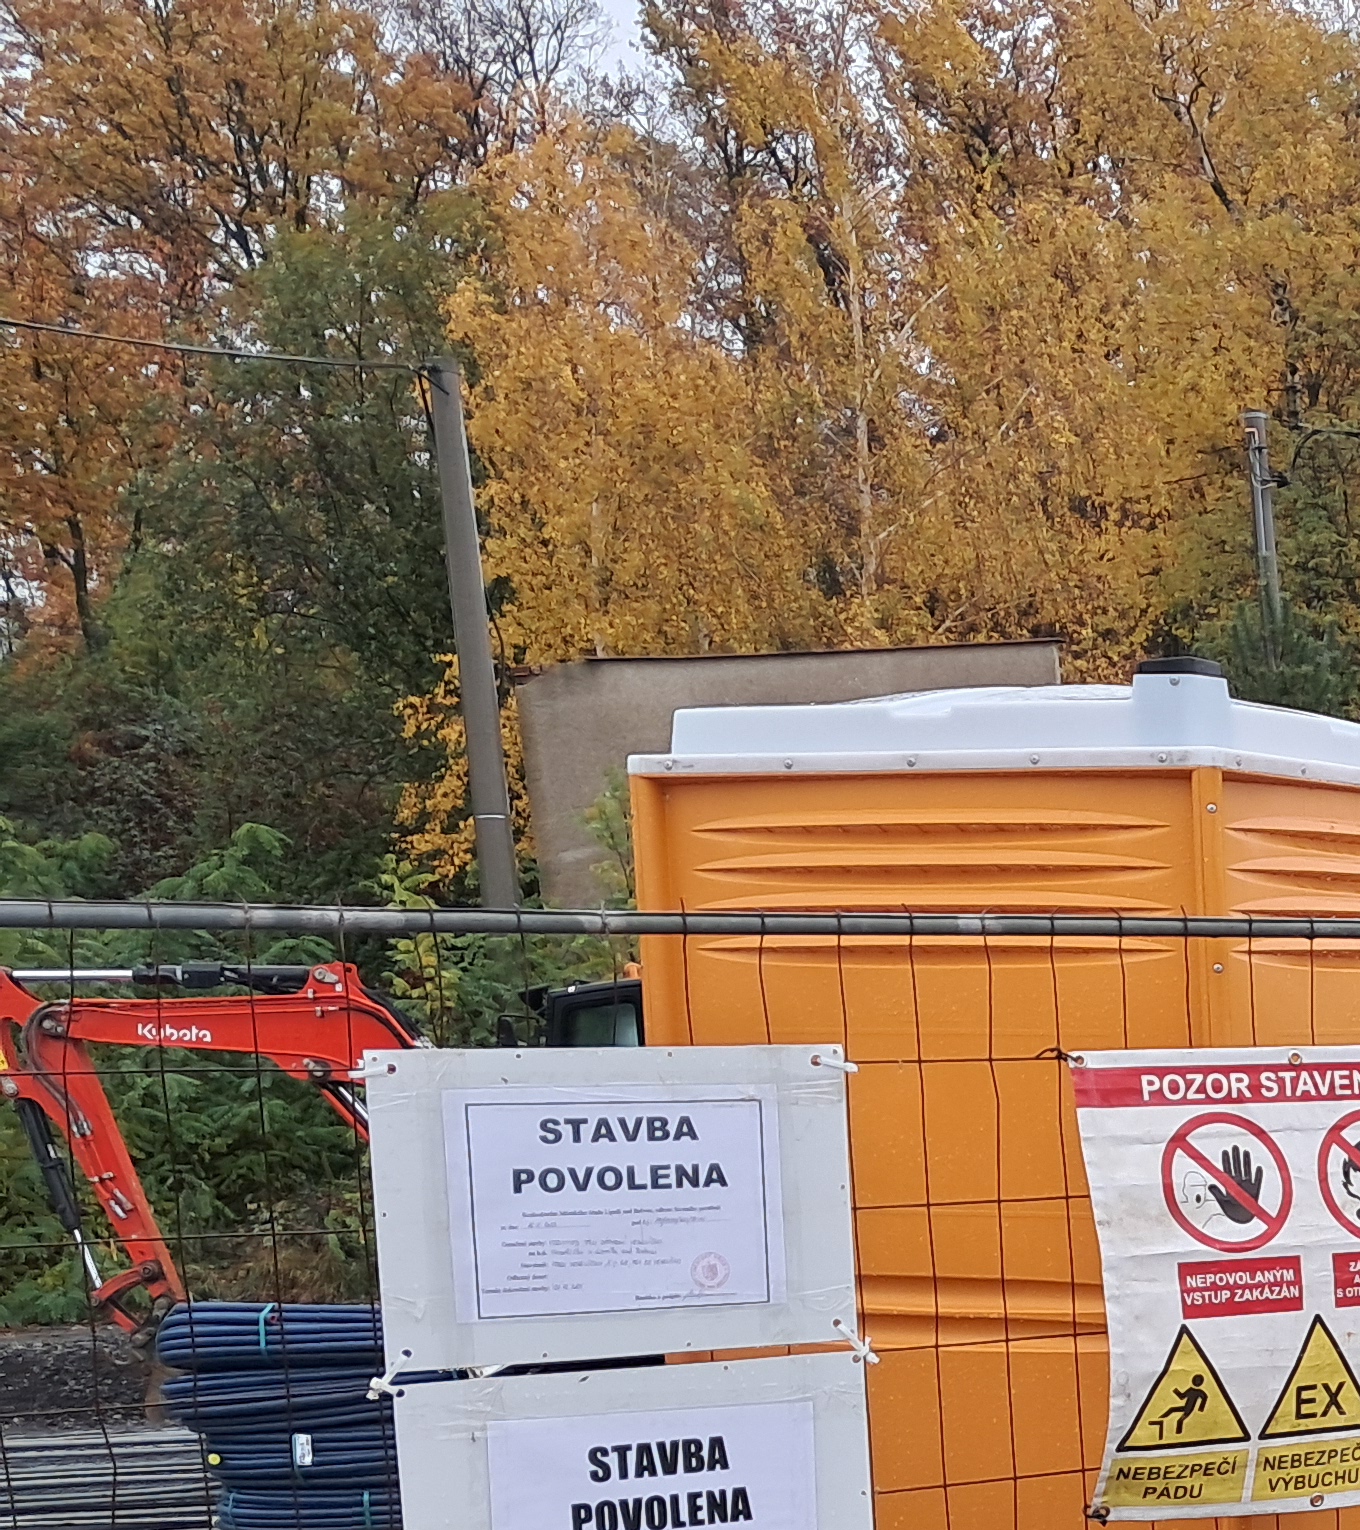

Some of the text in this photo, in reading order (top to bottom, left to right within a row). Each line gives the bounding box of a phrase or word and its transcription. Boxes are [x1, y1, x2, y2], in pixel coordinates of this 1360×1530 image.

[138, 1024, 211, 1042] Kubota
[1141, 1073, 1252, 1101] POZOR
[539, 1116, 699, 1144] STAVBA
[513, 1163, 728, 1194] POVOLENA
[1187, 1267, 1294, 1288] NEPOVOLANÝM
[1354, 1274, 1360, 1283] A
[1184, 1283, 1299, 1305] VSTUP ZAKÁZÁN
[1337, 1288, 1343, 1297] S
[1295, 1381, 1346, 1420] EX
[588, 1436, 729, 1482] STAVBA
[1115, 1459, 1237, 1482] NEBEZPEČÍ
[1142, 1482, 1203, 1499] PÁDU
[1269, 1468, 1359, 1492] VÝBUCHU
